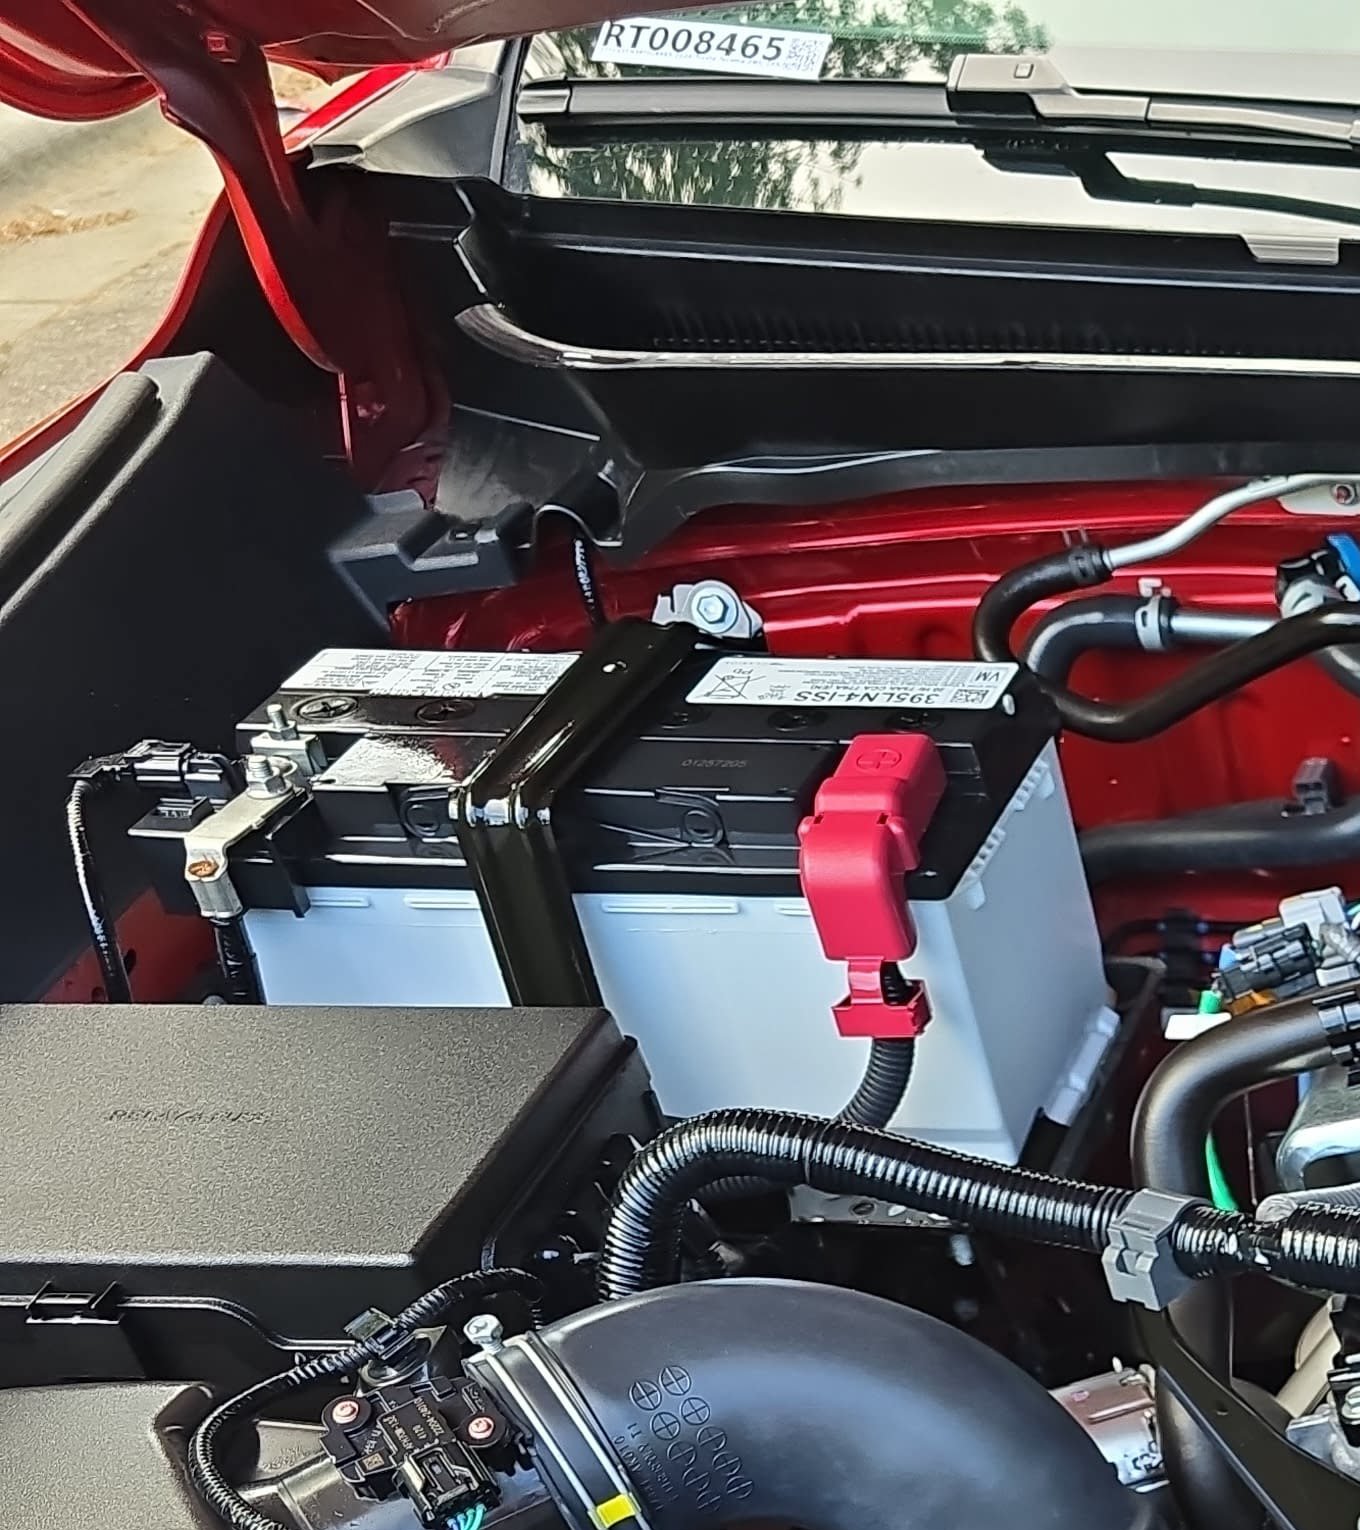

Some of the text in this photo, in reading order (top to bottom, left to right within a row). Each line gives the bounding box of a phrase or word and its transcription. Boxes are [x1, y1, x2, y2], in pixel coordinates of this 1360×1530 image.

[603, 24, 785, 61] RT008465
[975, 672, 1007, 682] VM
[793, 691, 941, 705] 395LN4-ISS
